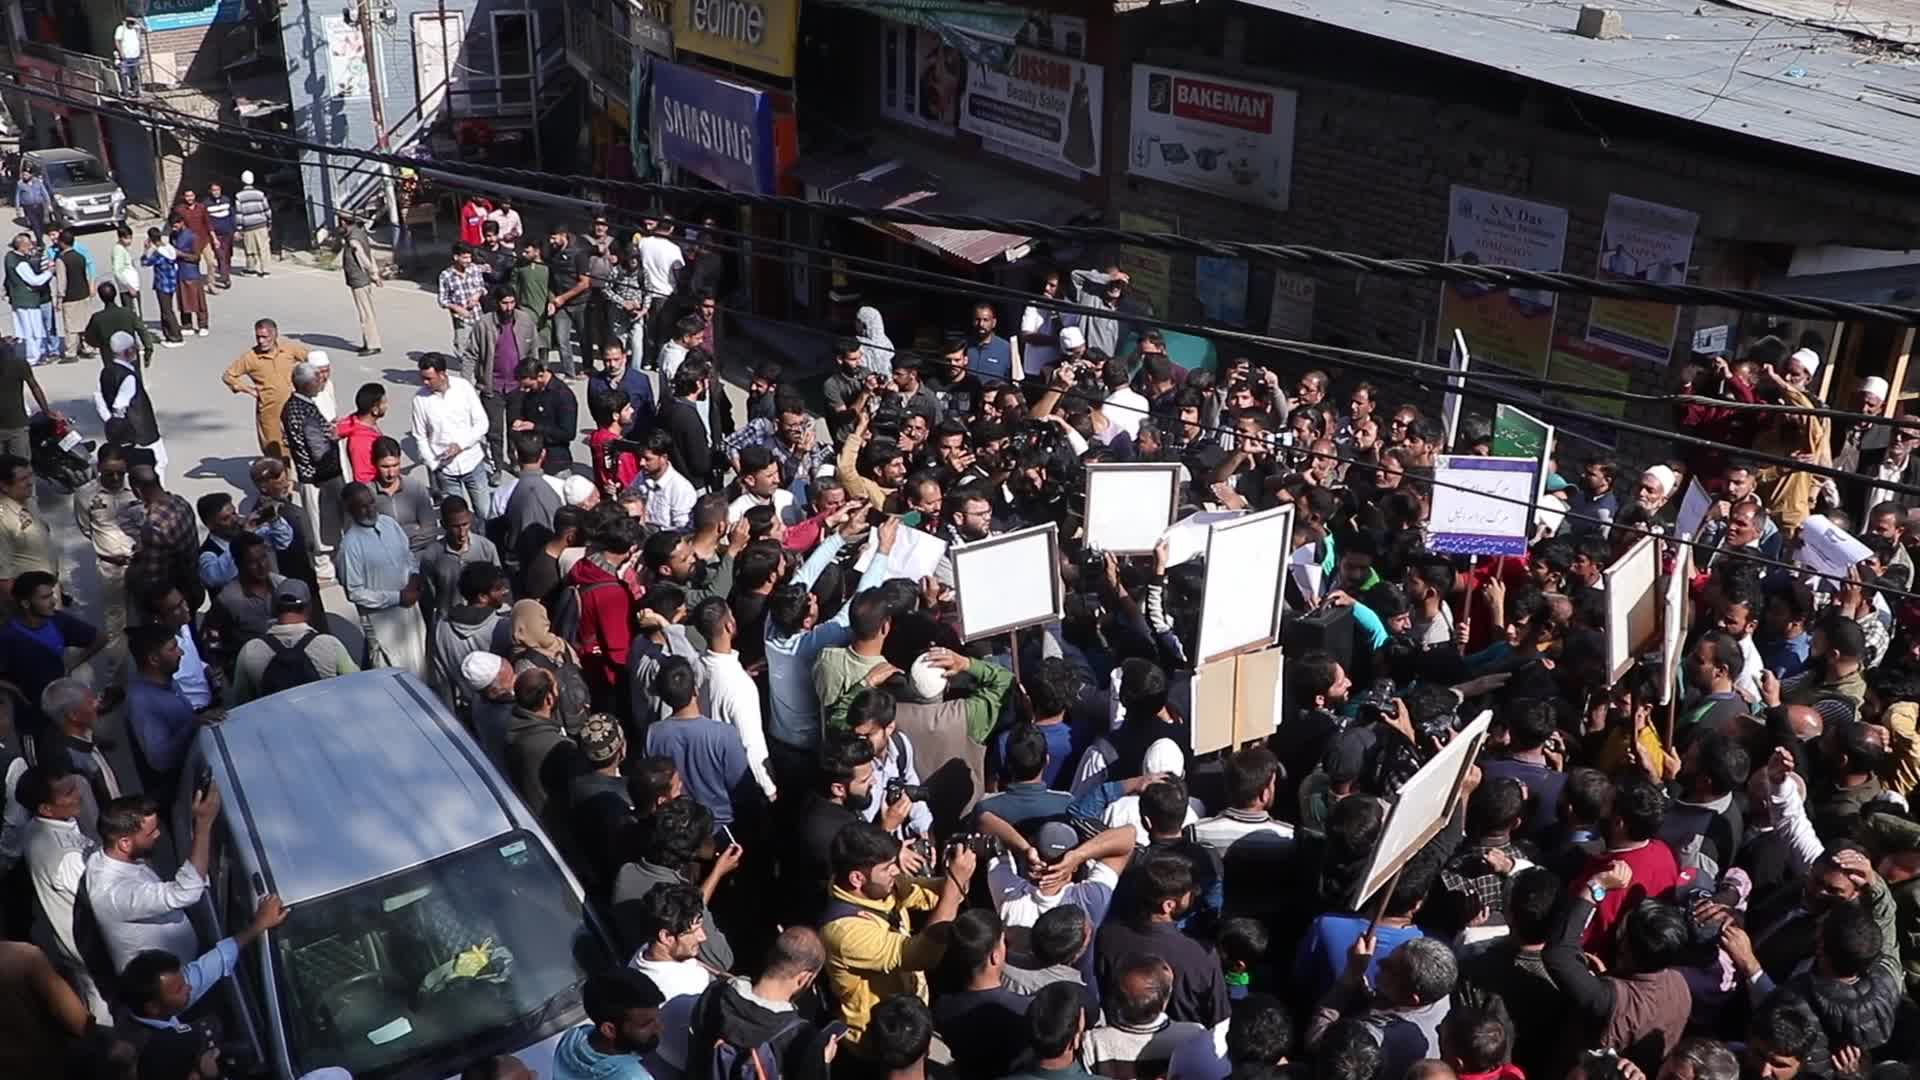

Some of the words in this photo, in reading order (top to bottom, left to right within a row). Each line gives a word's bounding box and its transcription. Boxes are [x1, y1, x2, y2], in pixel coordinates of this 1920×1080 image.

[688, 0, 762, 44] realme
[1007, 80, 1037, 108] Beauty
[1176, 84, 1266, 119] BAKEMAN
[662, 95, 753, 166] SAMSUNG
[1488, 202, 1500, 217] S
[1503, 205, 1516, 218] N
